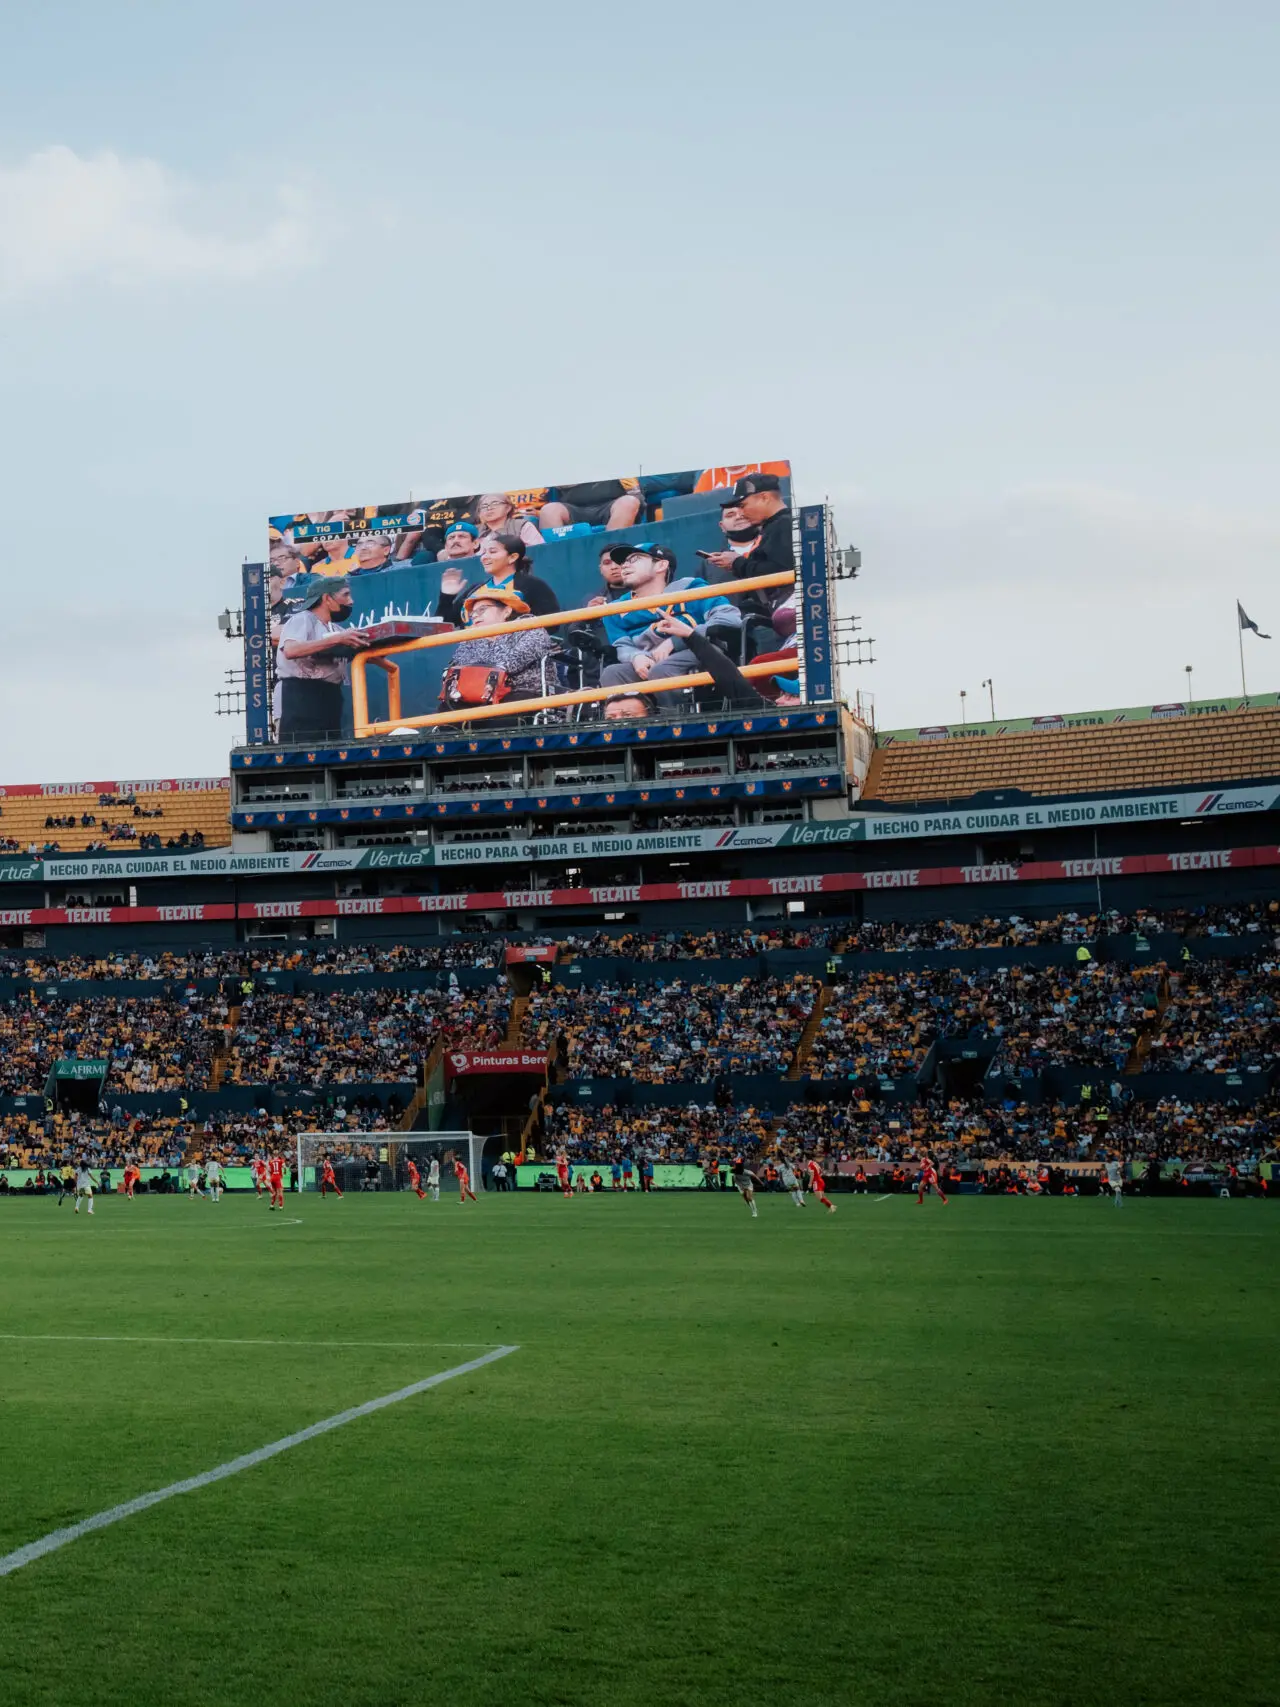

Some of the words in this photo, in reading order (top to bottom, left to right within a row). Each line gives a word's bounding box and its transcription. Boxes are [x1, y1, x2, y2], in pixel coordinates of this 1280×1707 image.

[381, 517, 402, 526] BAY
[430, 511, 455, 521] 42:24
[349, 520, 367, 530] 1-0
[312, 534, 340, 542] COPA
[346, 528, 403, 539] AMAZONAS
[807, 540, 824, 663] TIGRES
[248, 595, 264, 708] TIGRES
[40, 783, 86, 795] TECATE
[116, 780, 163, 793] TECATE
[176, 778, 221, 791] TECATE
[1217, 800, 1264, 811] CEMEX
[873, 820, 920, 835] HECHO
[924, 818, 962, 832] PARA
[966, 813, 1019, 829] CUIDAR
[1025, 812, 1043, 825] EL
[1048, 807, 1096, 823] MEDIO
[1100, 801, 1178, 819] AMBIENTE
[733, 837, 773, 847] CEMEX
[792, 825, 852, 843] Vertua
[441, 847, 482, 861] HECHO
[485, 845, 519, 859] PARA
[573, 842, 588, 854] EL
[592, 839, 633, 853] MEDIO
[636, 835, 702, 850] AMBIENTE
[50, 863, 88, 876] HECHO
[92, 862, 123, 875] PARA
[126, 861, 169, 873] CUIDAR
[173, 860, 187, 872] EL
[190, 858, 227, 871] MEDIO
[229, 856, 290, 871] AMBIENTE
[317, 859, 353, 868] CEMEX
[369, 850, 423, 866] Vertua
[1167, 850, 1233, 870] TECATE
[960, 864, 1019, 883] TECATE
[1061, 857, 1124, 877] TECATE
[768, 876, 824, 894] TECATE
[863, 869, 921, 888] TECATE
[589, 886, 642, 903] TECATE
[677, 881, 731, 898] TECATE
[335, 898, 384, 914] TECATE
[418, 894, 469, 911] TECATE
[503, 890, 553, 907] TECATE
[65, 908, 113, 923] TECATE
[156, 904, 204, 920] TECATE
[254, 901, 302, 918] TECATE
[473, 1055, 518, 1066] Pinturas
[522, 1055, 548, 1065] Bere
